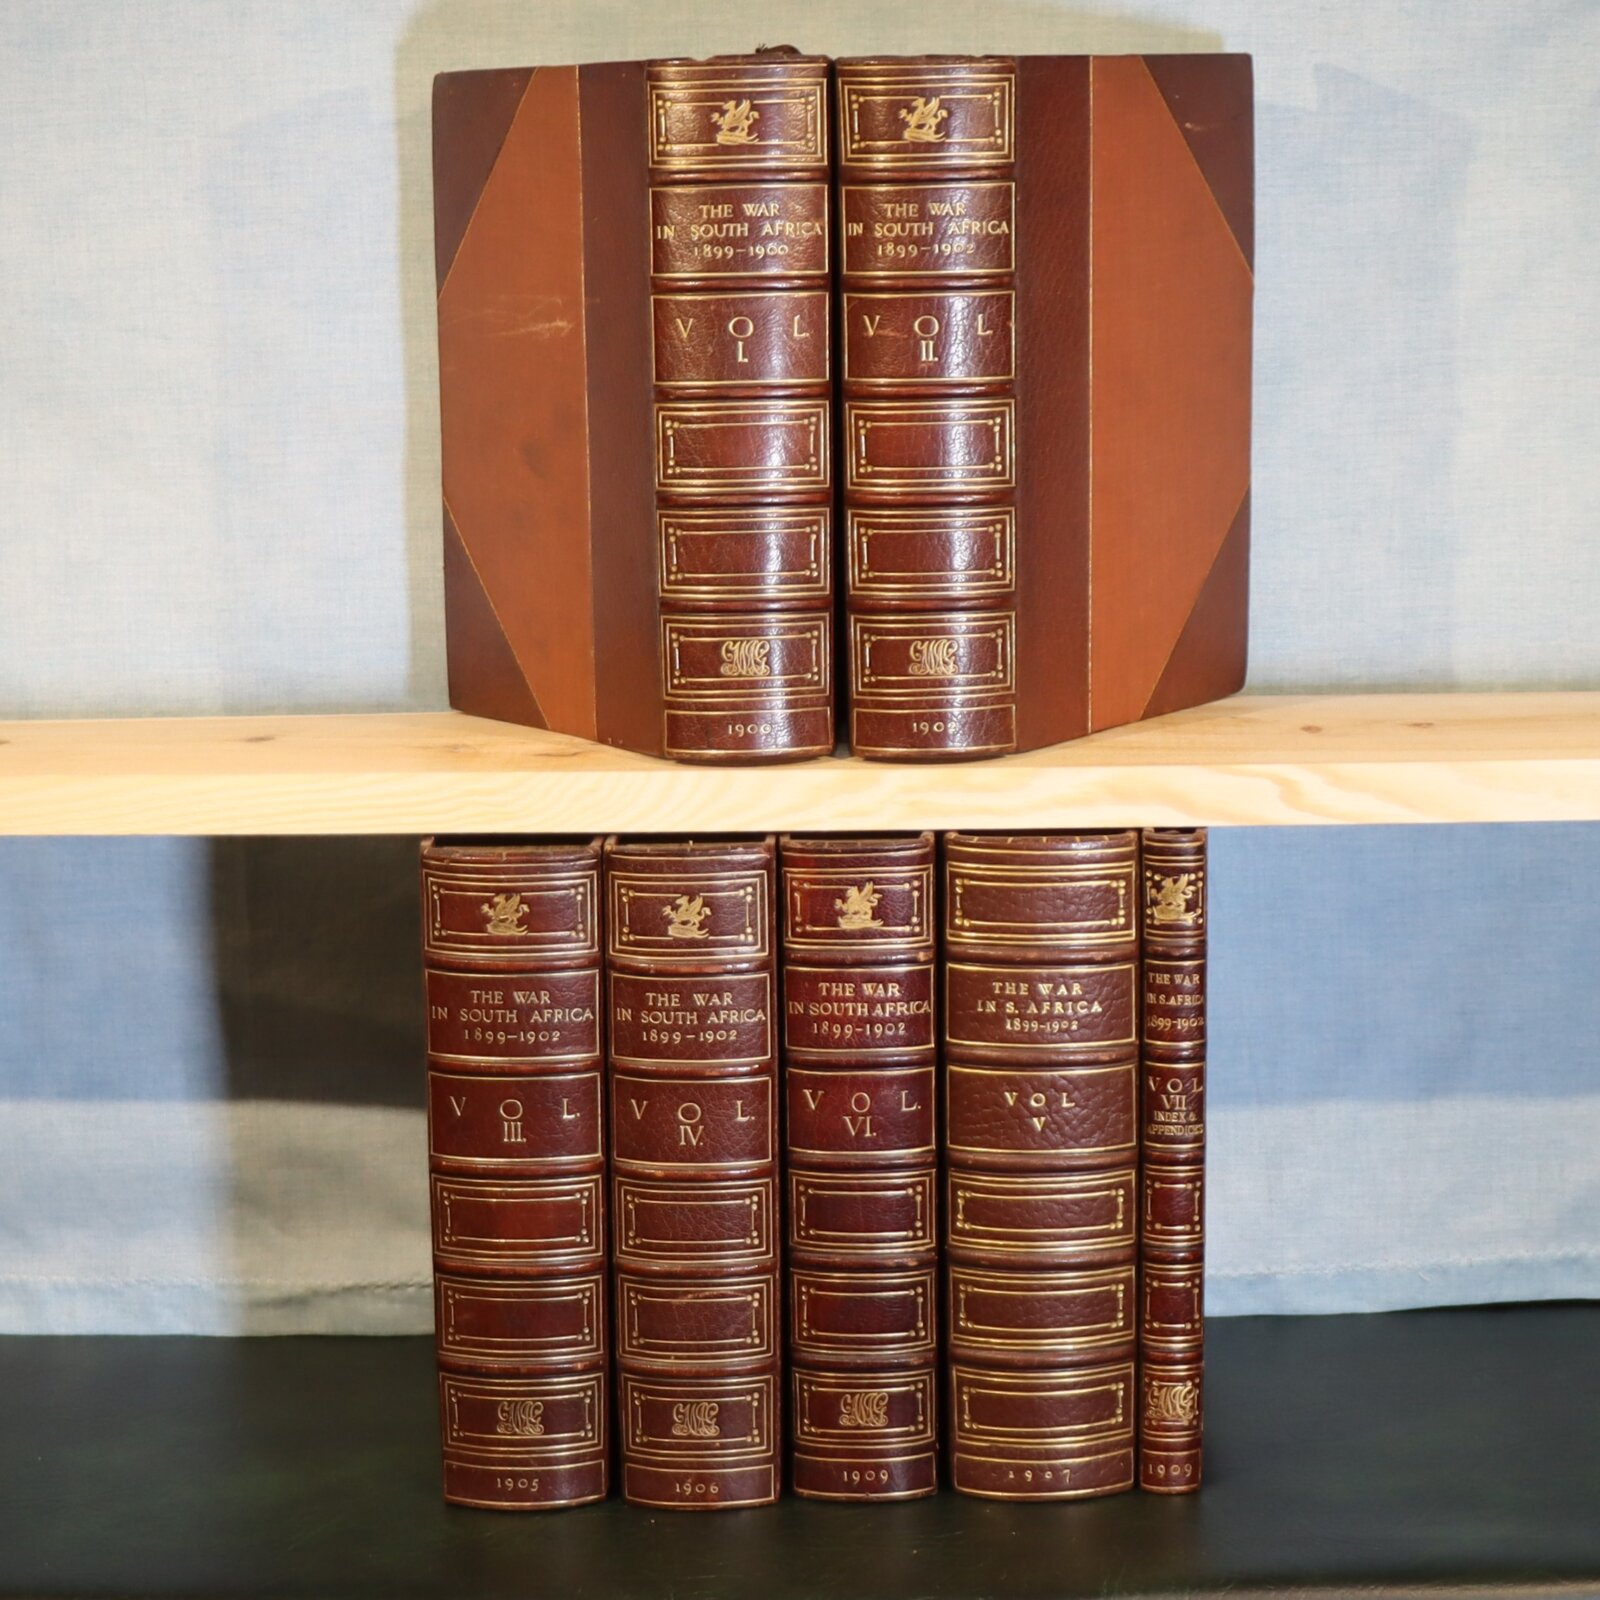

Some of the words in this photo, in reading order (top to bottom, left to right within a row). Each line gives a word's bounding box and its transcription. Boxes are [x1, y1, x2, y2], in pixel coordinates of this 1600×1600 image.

[699, 204, 734, 219] THE
[742, 203, 780, 218] WAR
[884, 203, 919, 218] THE
[928, 202, 967, 216] WAR
[656, 225, 675, 240] IN
[690, 223, 749, 240] SOUTH
[761, 222, 823, 237] AFRICA
[848, 223, 864, 237] IN
[874, 222, 934, 238] SOUTH
[947, 221, 1010, 236] AFRICA
[727, 722, 772, 738] 1900
[1148, 971, 1172, 985] THE
[1173, 973, 1201, 987] WAR
[818, 982, 855, 997] THE
[861, 982, 902, 998] WAR
[992, 982, 1030, 996] THE
[1037, 982, 1083, 996] WAR
[470, 990, 504, 1005] THE
[513, 990, 551, 1005] WAR
[645, 992, 681, 1007] THE
[693, 992, 733, 1007] WAR
[431, 1006, 448, 1020] IN
[460, 1008, 518, 1024] SOUTH
[530, 1007, 594, 1024] AFRICA
[788, 1001, 804, 1015] IN
[808, 1002, 869, 1017] SOUTH
[872, 1000, 932, 1017] AFRICA
[977, 1000, 997, 1013] IN
[1005, 1001, 1020, 1014] S.
[1026, 1001, 1103, 1015] AFRICA
[616, 1007, 632, 1022] IN
[640, 1011, 699, 1025] SOUTH
[706, 1009, 767, 1024] AFRICA
[1032, 1116, 1046, 1132] V
[1154, 1110, 1187, 1123] INDEX
[842, 1115, 878, 1138] VI.
[843, 1470, 889, 1485] 1909
[1149, 1463, 1193, 1478] 1909
[496, 1477, 539, 1492] 1905
[675, 1482, 719, 1495] 1906
